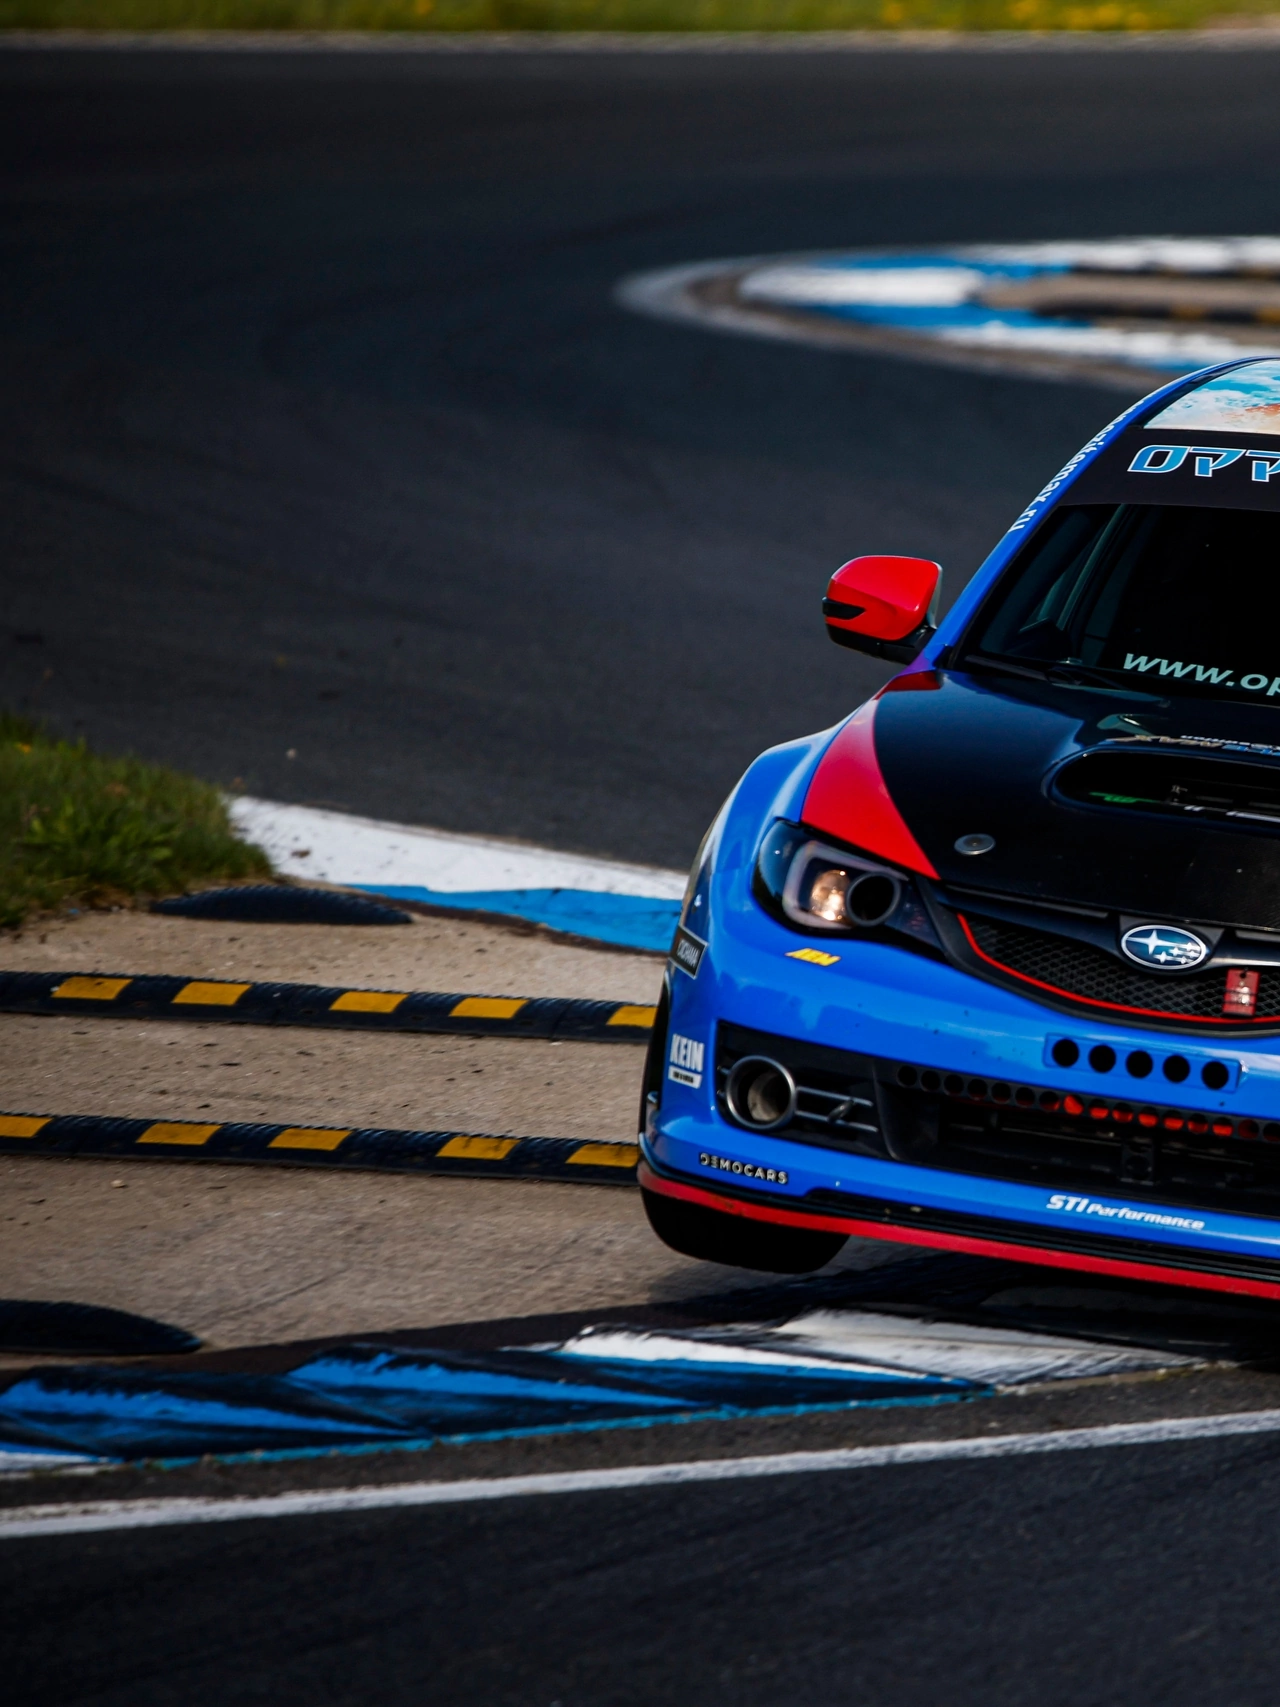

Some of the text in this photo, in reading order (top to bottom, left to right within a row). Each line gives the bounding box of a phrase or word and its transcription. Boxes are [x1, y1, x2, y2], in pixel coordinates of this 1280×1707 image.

[669, 1033, 705, 1073] KEIN
[700, 1152, 788, 1185] DEMOCARS
[1046, 1194, 1205, 1231] STI Performance
